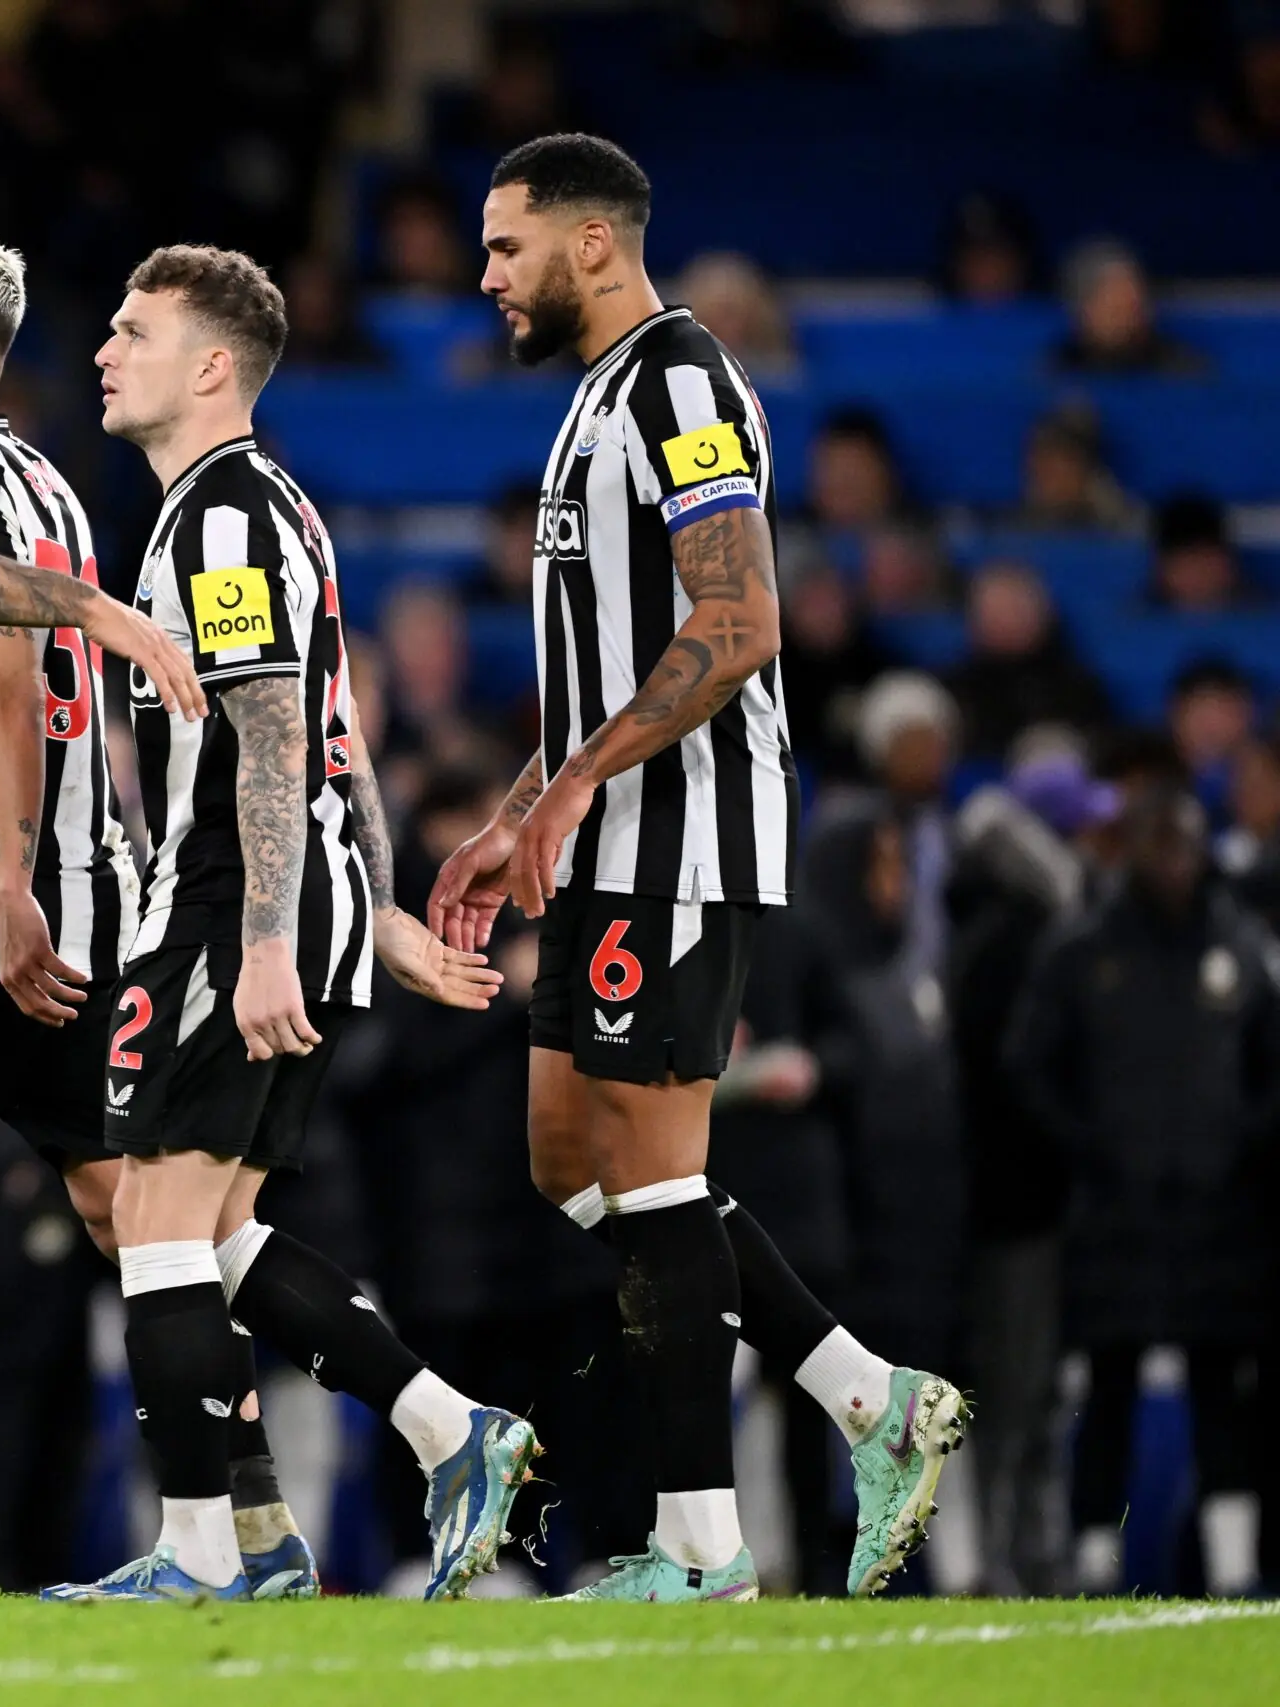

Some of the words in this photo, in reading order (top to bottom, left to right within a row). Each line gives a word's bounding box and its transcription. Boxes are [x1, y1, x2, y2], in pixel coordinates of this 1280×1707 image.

[680, 493, 701, 508] EFL
[702, 481, 749, 498] CAPTAIN
[203, 613, 266, 639] noon
[589, 919, 643, 1001] 6
[109, 986, 153, 1070] 2
[594, 1034, 630, 1044] CASTORE
